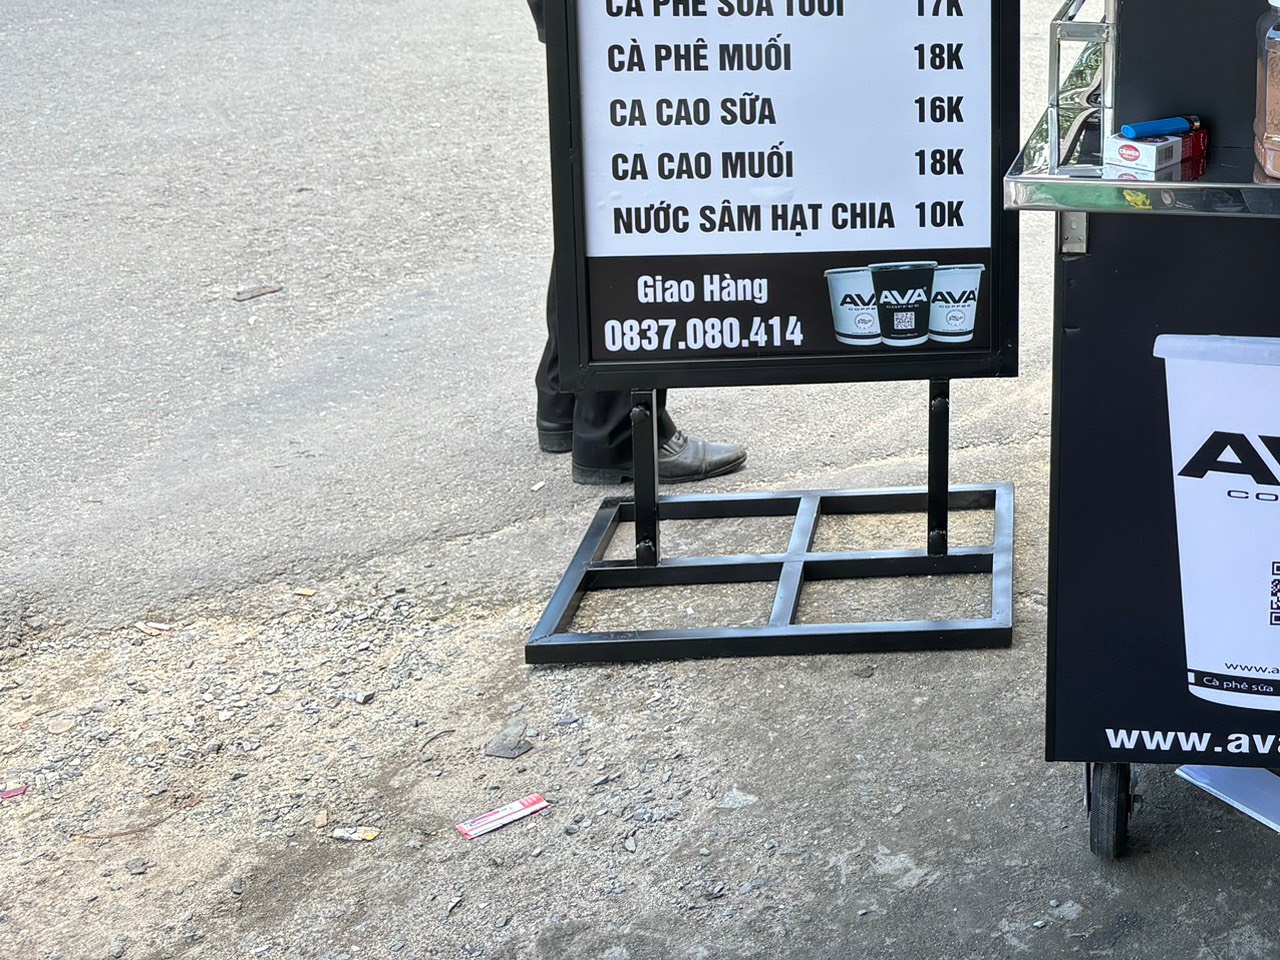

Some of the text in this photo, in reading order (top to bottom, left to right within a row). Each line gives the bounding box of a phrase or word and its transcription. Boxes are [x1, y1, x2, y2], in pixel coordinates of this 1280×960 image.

[607, 33, 964, 72] CÀ PHÊ MUỐI 18K
[609, 92, 964, 127] CA CAO SỮA 16K
[611, 141, 964, 181] CA CAO MUỐI 18K
[613, 199, 964, 237] NƯỚC SÂM HẠT CHIA 10K
[637, 274, 768, 304] Giao Hàng
[840, 293, 877, 306] AV
[879, 288, 928, 304] AVA
[931, 290, 977, 304] AVA
[604, 314, 804, 352] 0837.080.414
[1203, 676, 1274, 693] Cà phê sữa
